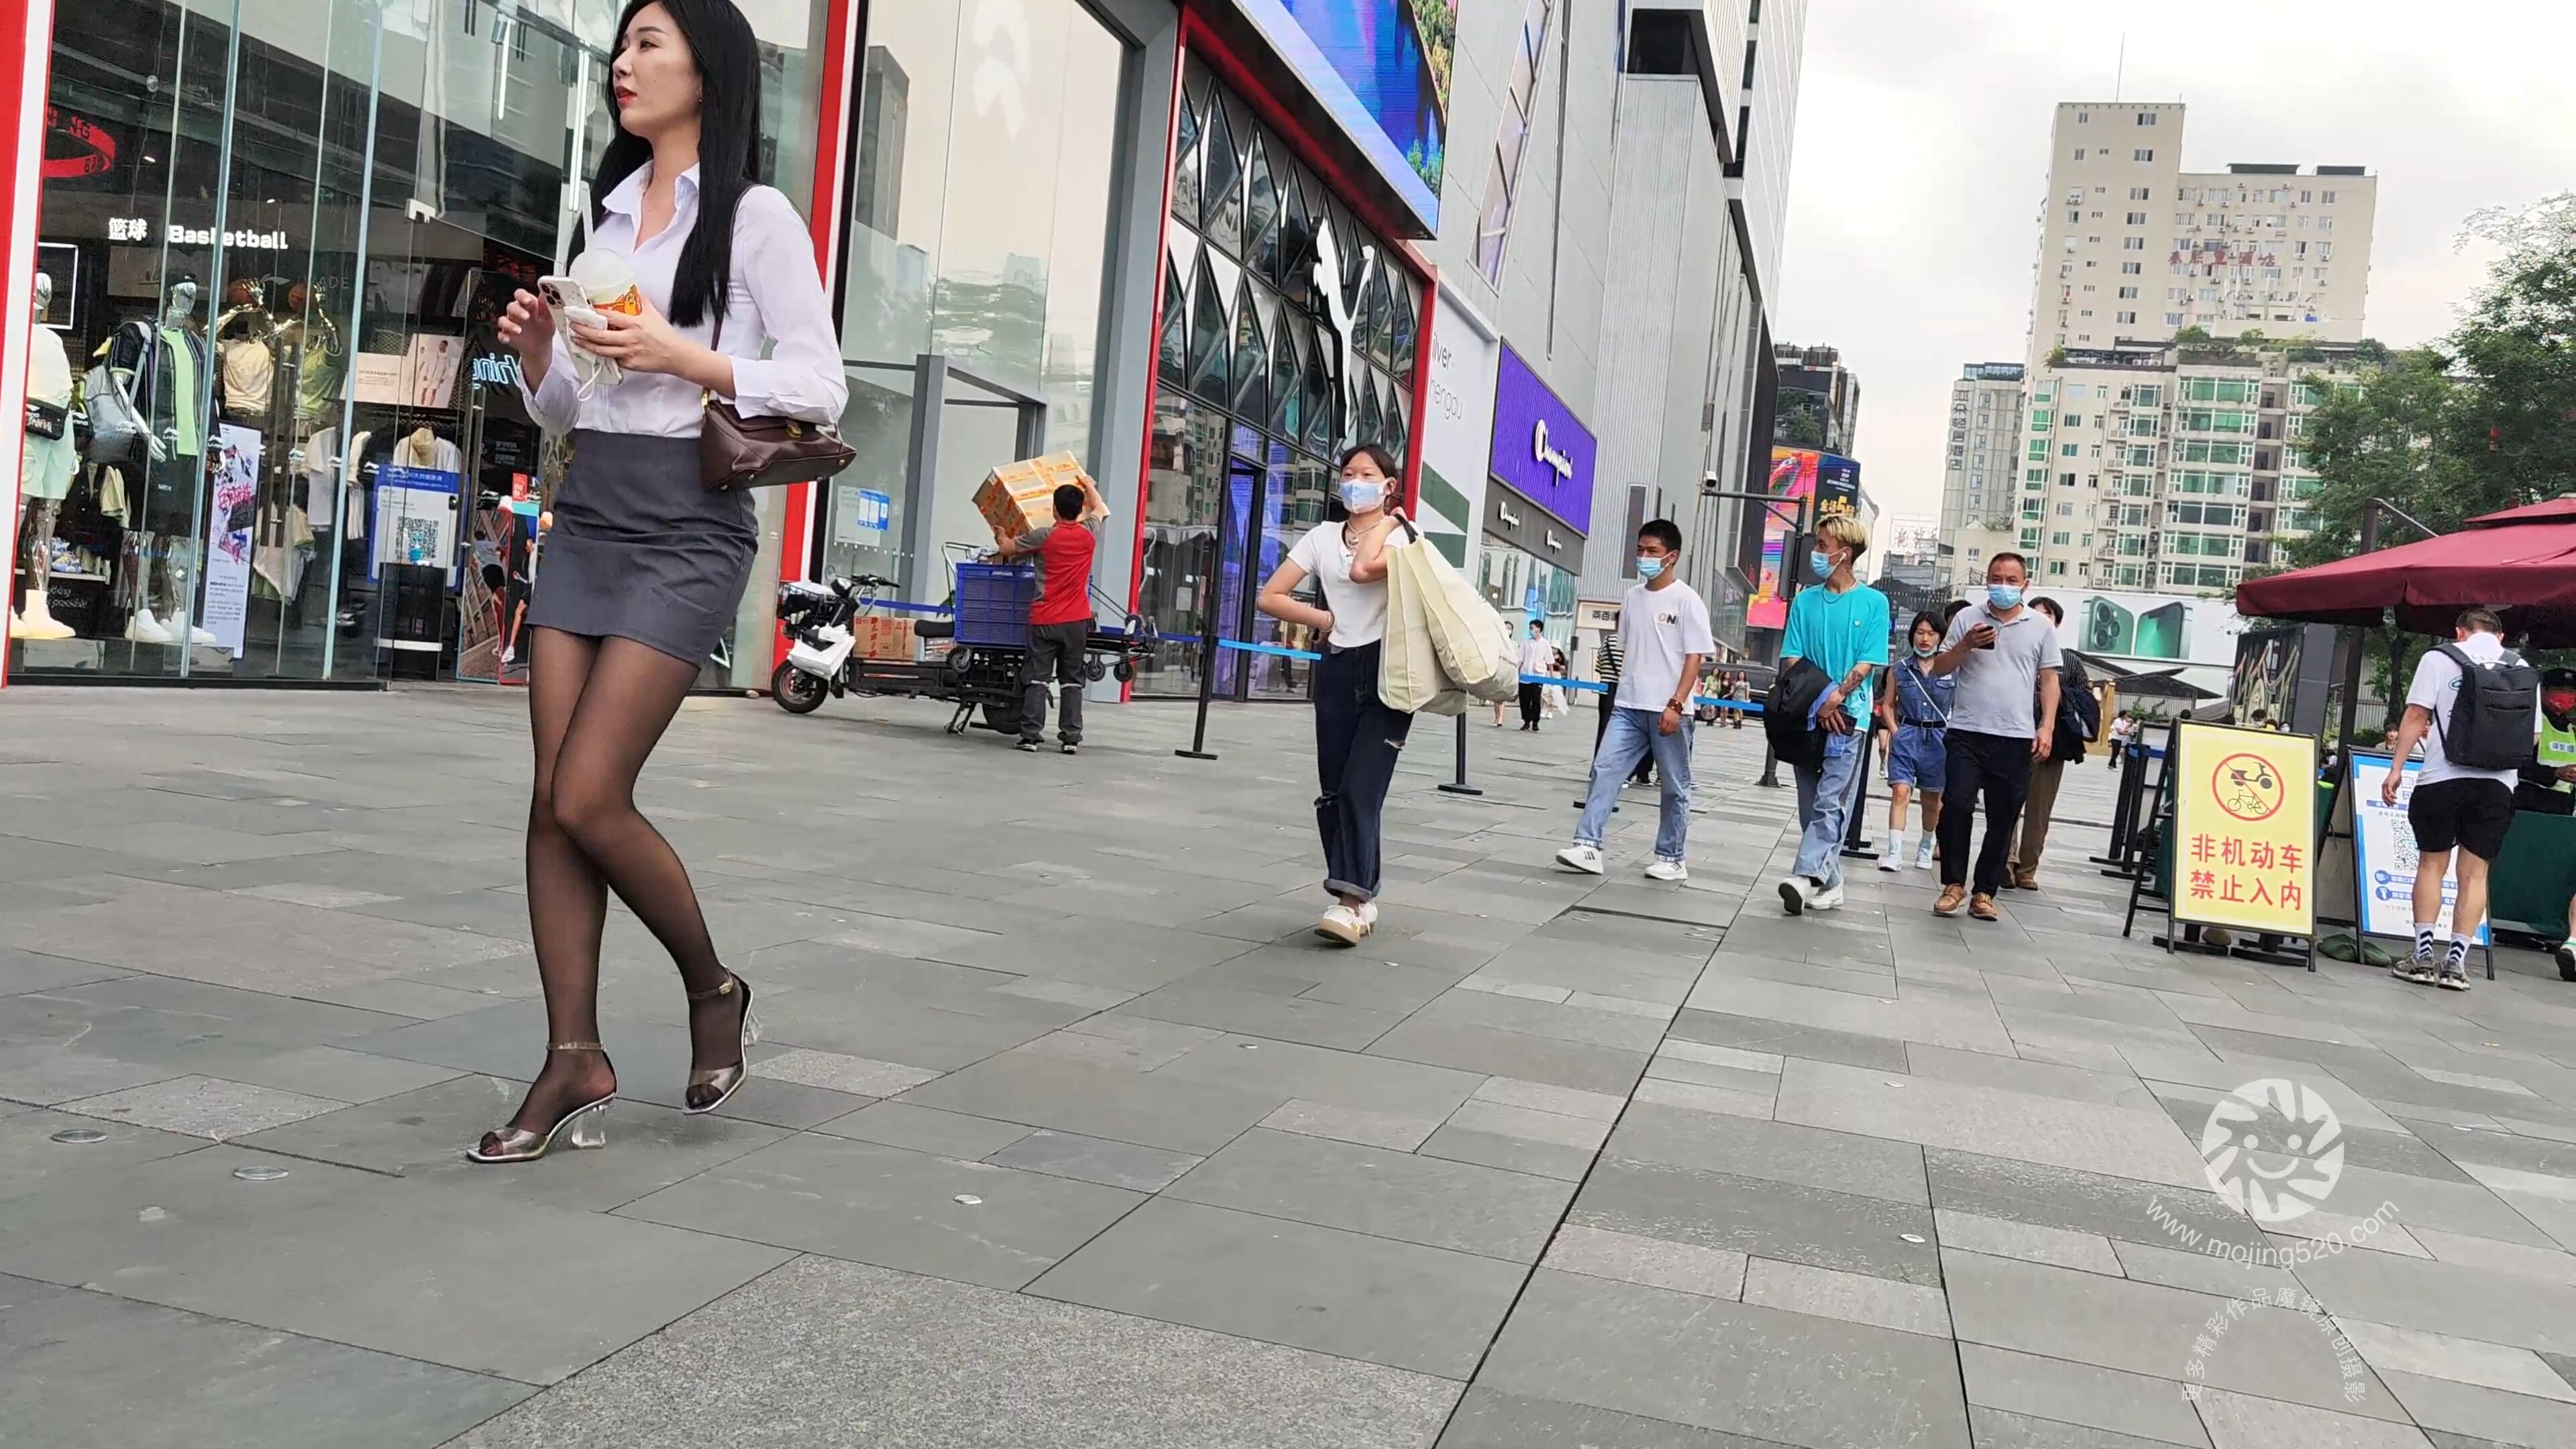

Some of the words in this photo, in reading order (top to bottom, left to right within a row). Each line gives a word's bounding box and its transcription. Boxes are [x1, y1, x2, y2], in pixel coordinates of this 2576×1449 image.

[108, 218, 147, 241] 篮球
[1432, 331, 1452, 370] ilver
[1535, 419, 1574, 487] Champion
[2191, 834, 2303, 873] 非机动车
[2190, 869, 2302, 911] 禁止入内
